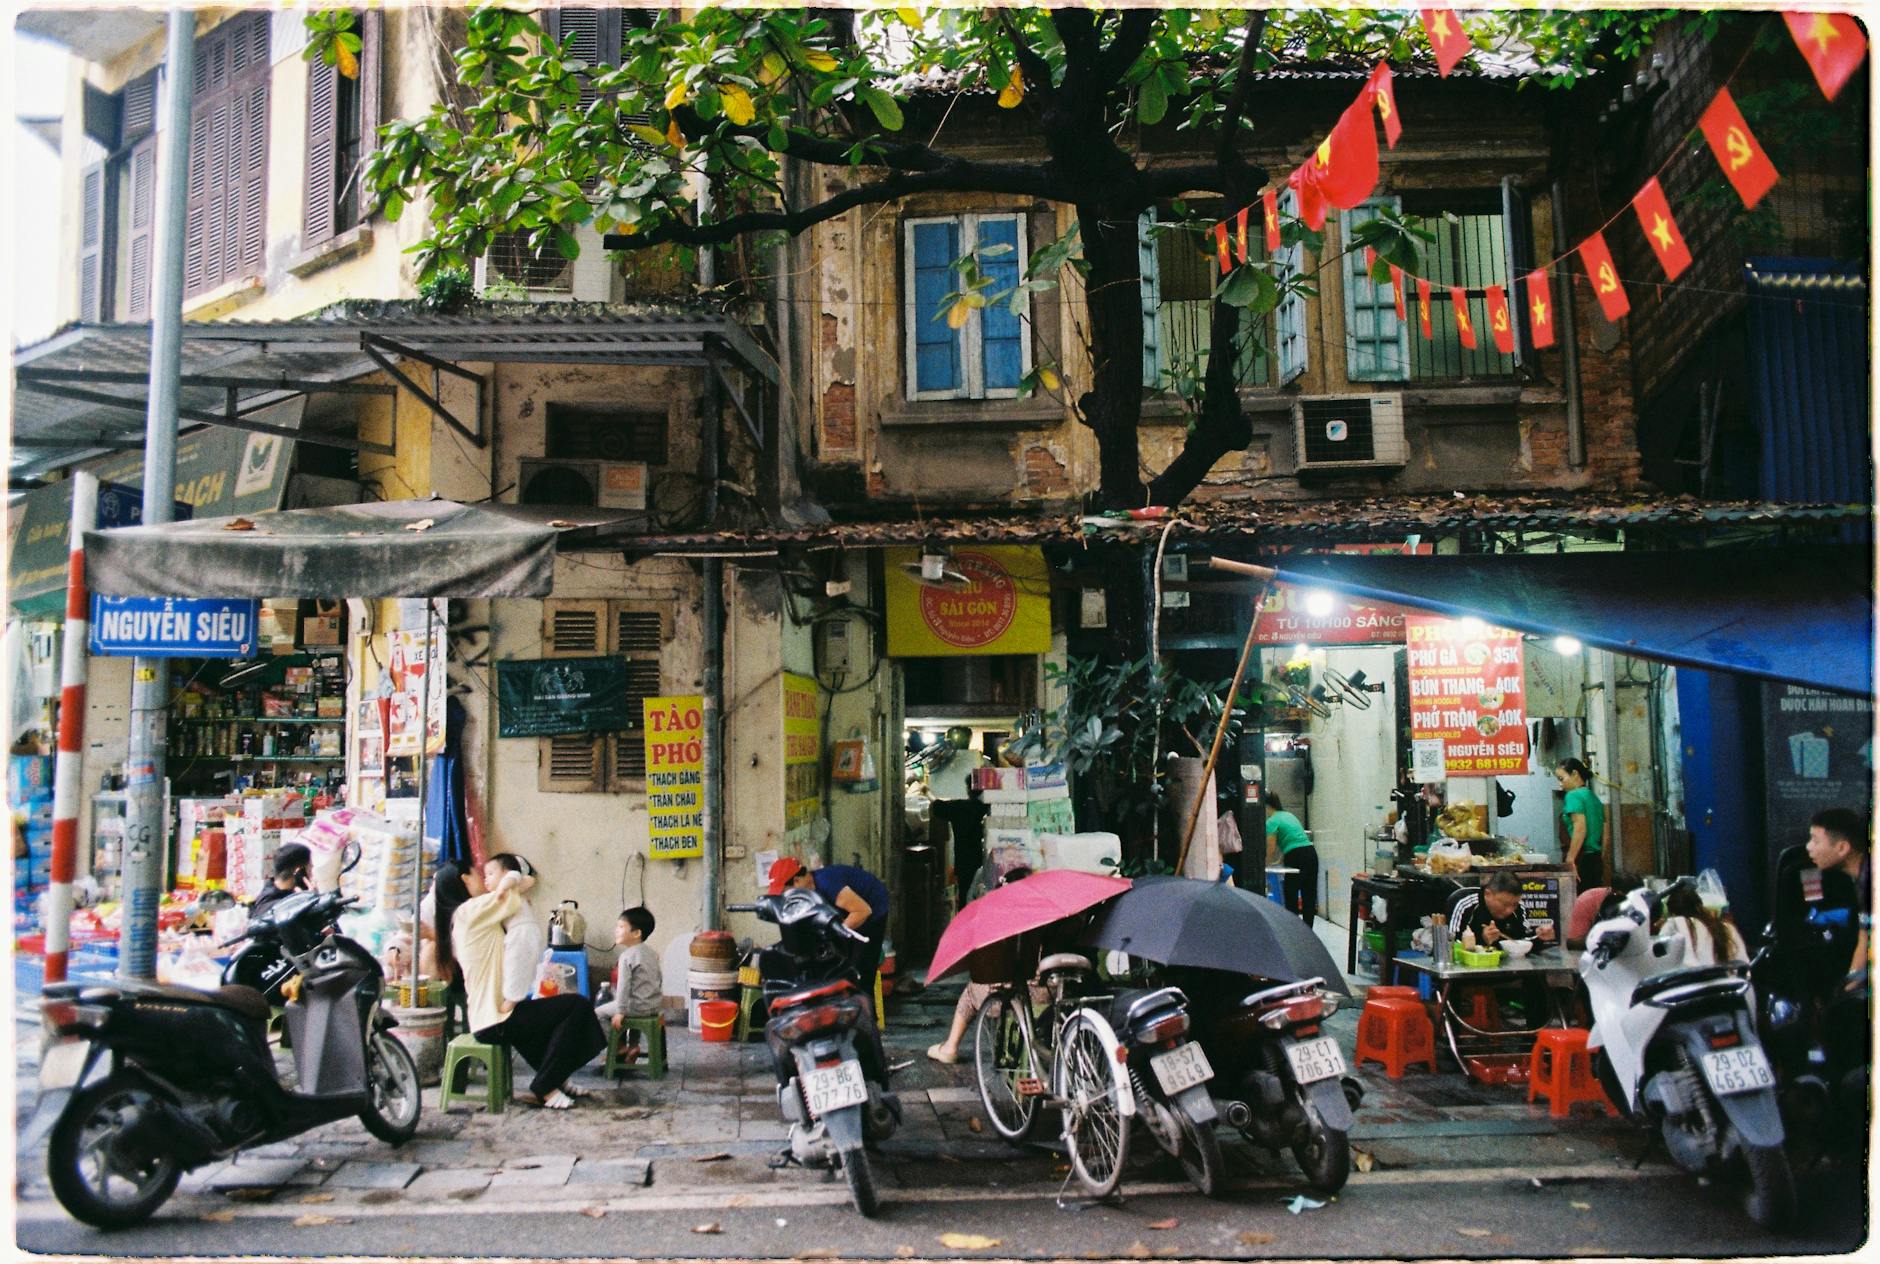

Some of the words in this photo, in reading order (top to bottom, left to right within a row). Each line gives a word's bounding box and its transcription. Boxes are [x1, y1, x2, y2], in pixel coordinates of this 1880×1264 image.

[102, 602, 191, 641] NGUYỄN
[196, 606, 246, 642] SIÊU
[1356, 612, 1402, 628] SÁNG
[1410, 642, 1437, 667] PHỞ
[1440, 646, 1458, 666] GÀ
[1493, 646, 1519, 664] 35K
[1411, 675, 1440, 696] BÚN
[1442, 677, 1485, 696] THANG
[1495, 676, 1521, 695] 40K
[650, 703, 702, 732] TÀO
[1413, 704, 1440, 728] PHỞ
[1443, 706, 1477, 731] TRỘN
[1498, 708, 1522, 726] 40K
[651, 735, 702, 765] PHỚ
[1448, 740, 1495, 757] NGUYỄN
[1497, 741, 1524, 756] SIÊU
[1445, 759, 1472, 769] 0932
[1475, 758, 1522, 769] 681957
[652, 772, 677, 789] THẠCH
[653, 815, 678, 832] THẠCH
[654, 837, 679, 853] THẠCH
[1297, 1041, 1332, 1063] 29-C1
